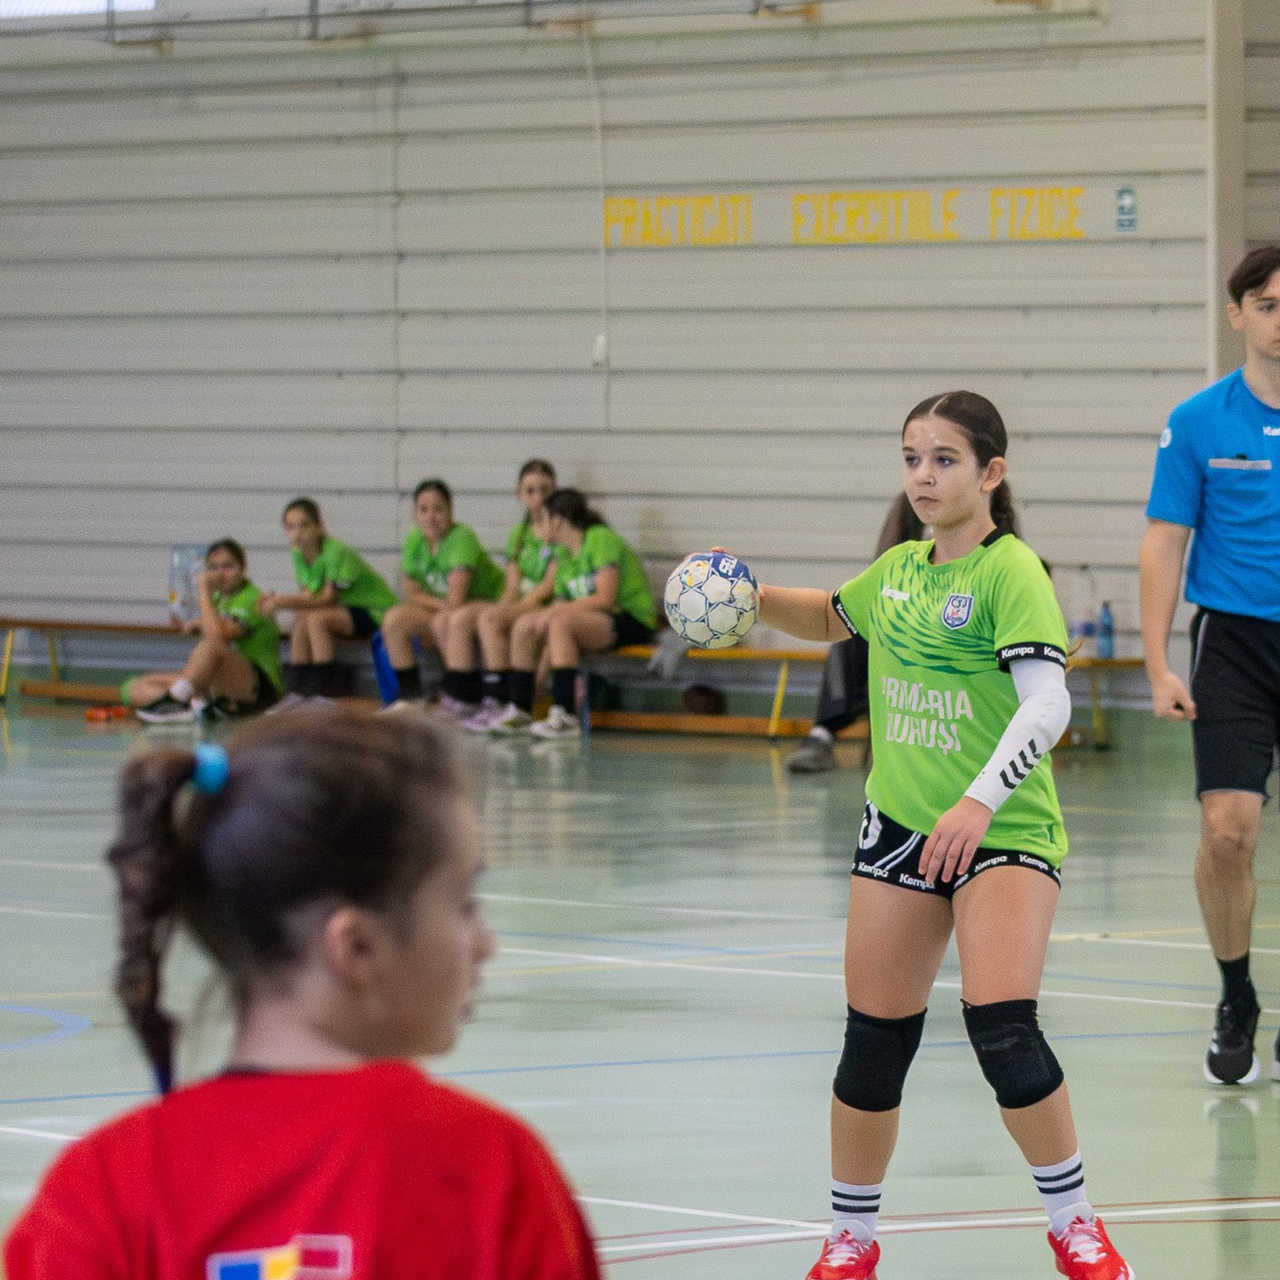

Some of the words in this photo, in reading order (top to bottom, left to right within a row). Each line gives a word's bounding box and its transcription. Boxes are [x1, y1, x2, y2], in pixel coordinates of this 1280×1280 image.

[989, 186, 1086, 241] FIZICE
[1001, 646, 1035, 659] Kempa
[858, 861, 890, 878] Kempa
[974, 855, 1008, 873] Kempa
[1019, 854, 1049, 871] Kempa
[899, 872, 936, 890] Kempa
